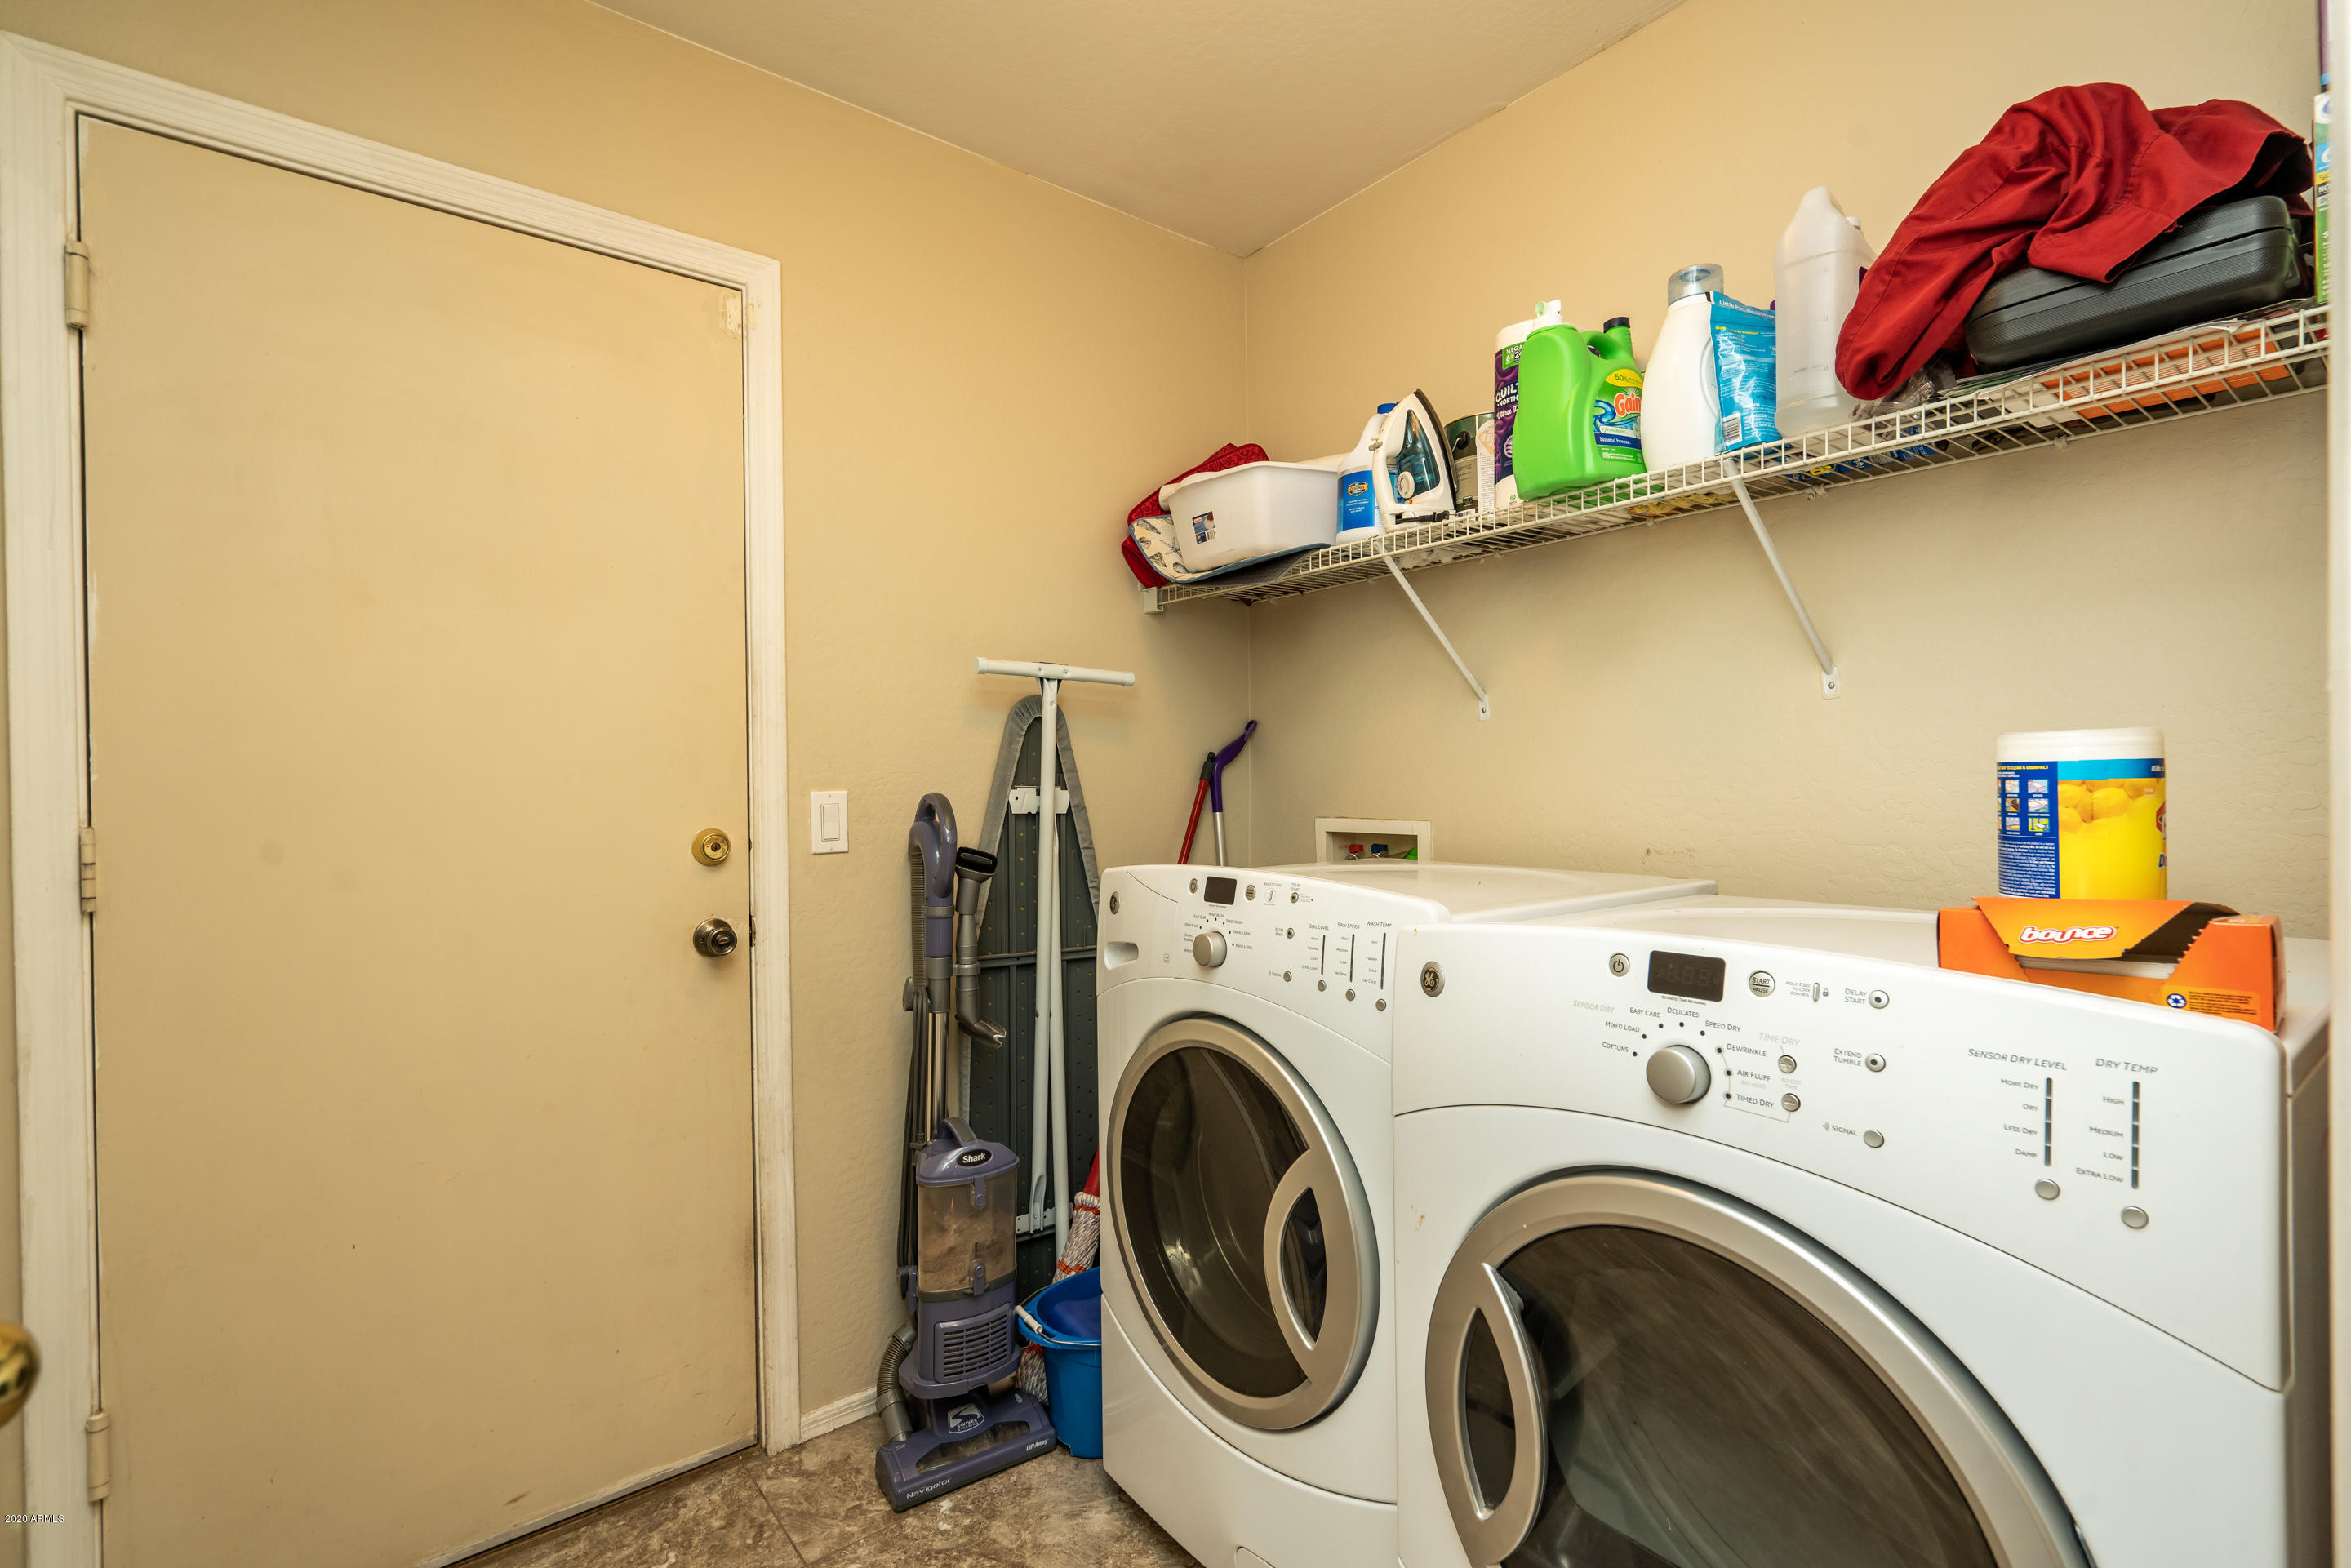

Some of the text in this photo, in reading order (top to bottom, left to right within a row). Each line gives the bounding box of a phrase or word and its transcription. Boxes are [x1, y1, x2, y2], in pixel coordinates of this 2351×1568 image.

[1506, 344, 1522, 354] MEGA
[1615, 393, 1641, 416] Gain
[2019, 926, 2115, 944] bounce
[1752, 976, 1771, 985] START
[1845, 988, 1867, 997] DELAY
[1572, 1000, 1615, 1014] SENSOR DRY
[1845, 997, 1866, 1005] START
[1629, 1006, 1661, 1019] EASY CARE
[1667, 1006, 1700, 1019] DELICATES
[1605, 1021, 1640, 1033] MIXED LOAD
[1705, 1019, 1741, 1033] SPEED DRY
[1759, 1032, 1801, 1046] TIME DRY
[1602, 1042, 1629, 1053] COTTONS
[1727, 1043, 1767, 1058] DEWRINKLE
[1834, 1048, 1862, 1059] EXTEND
[1833, 1056, 1861, 1067] TUMBLE
[1967, 1048, 2067, 1071] SENSOR DRY LEVEL
[2095, 1058, 2158, 1074] DRY TEMP
[1736, 1069, 1771, 1082] AIR FLUFF
[2001, 1078, 2039, 1090] MORE DRY
[1735, 1094, 1775, 1108] TIMED DRY
[2103, 1096, 2125, 1105] HIGH
[2023, 1103, 2038, 1111] DRY
[1831, 1124, 1857, 1136] SIGNAL
[2004, 1124, 2038, 1135] LESS DRY
[2090, 1126, 2124, 1138] MEDIUM
[962, 1153, 986, 1163] Shark
[2015, 1148, 2038, 1158] DAMP
[2103, 1152, 2124, 1161] LOW
[2076, 1167, 2124, 1183] EXTRA LOW
[957, 1419, 977, 1428] SWIVEL
[906, 1477, 951, 1499] Navigator
